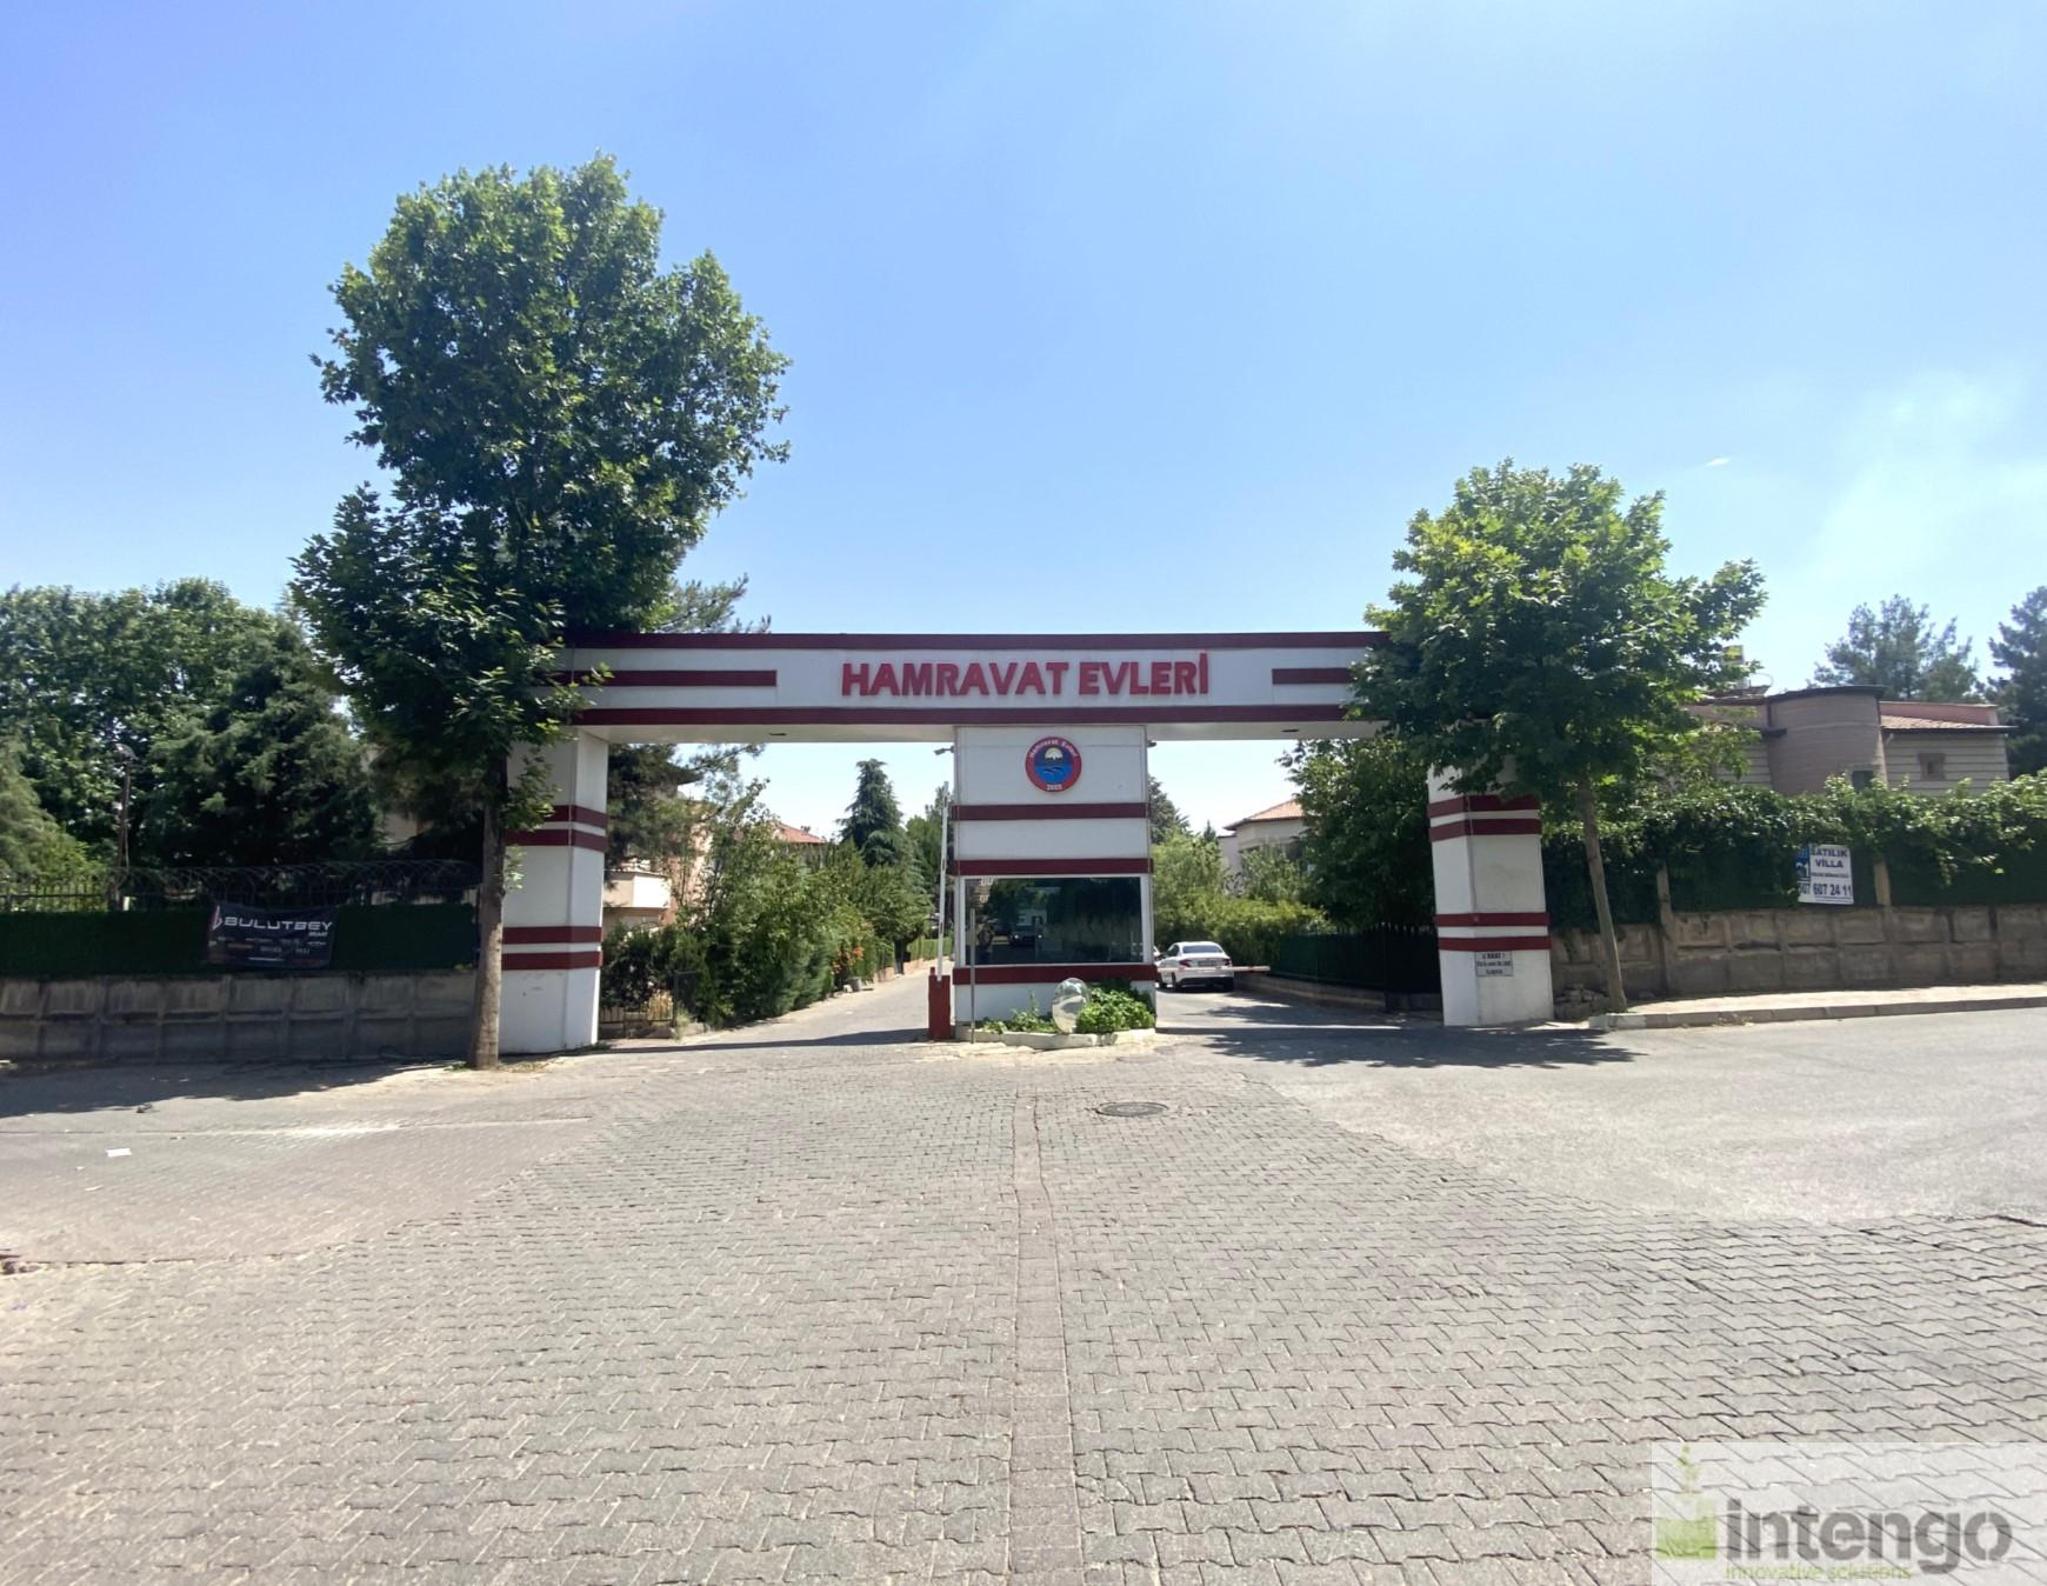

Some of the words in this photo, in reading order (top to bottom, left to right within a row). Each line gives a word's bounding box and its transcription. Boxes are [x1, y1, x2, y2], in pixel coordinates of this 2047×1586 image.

[842, 662, 1069, 697] HAMRAVAT
[1078, 653, 1209, 696] EVLERİ
[224, 916, 333, 931] BULUTBEY
